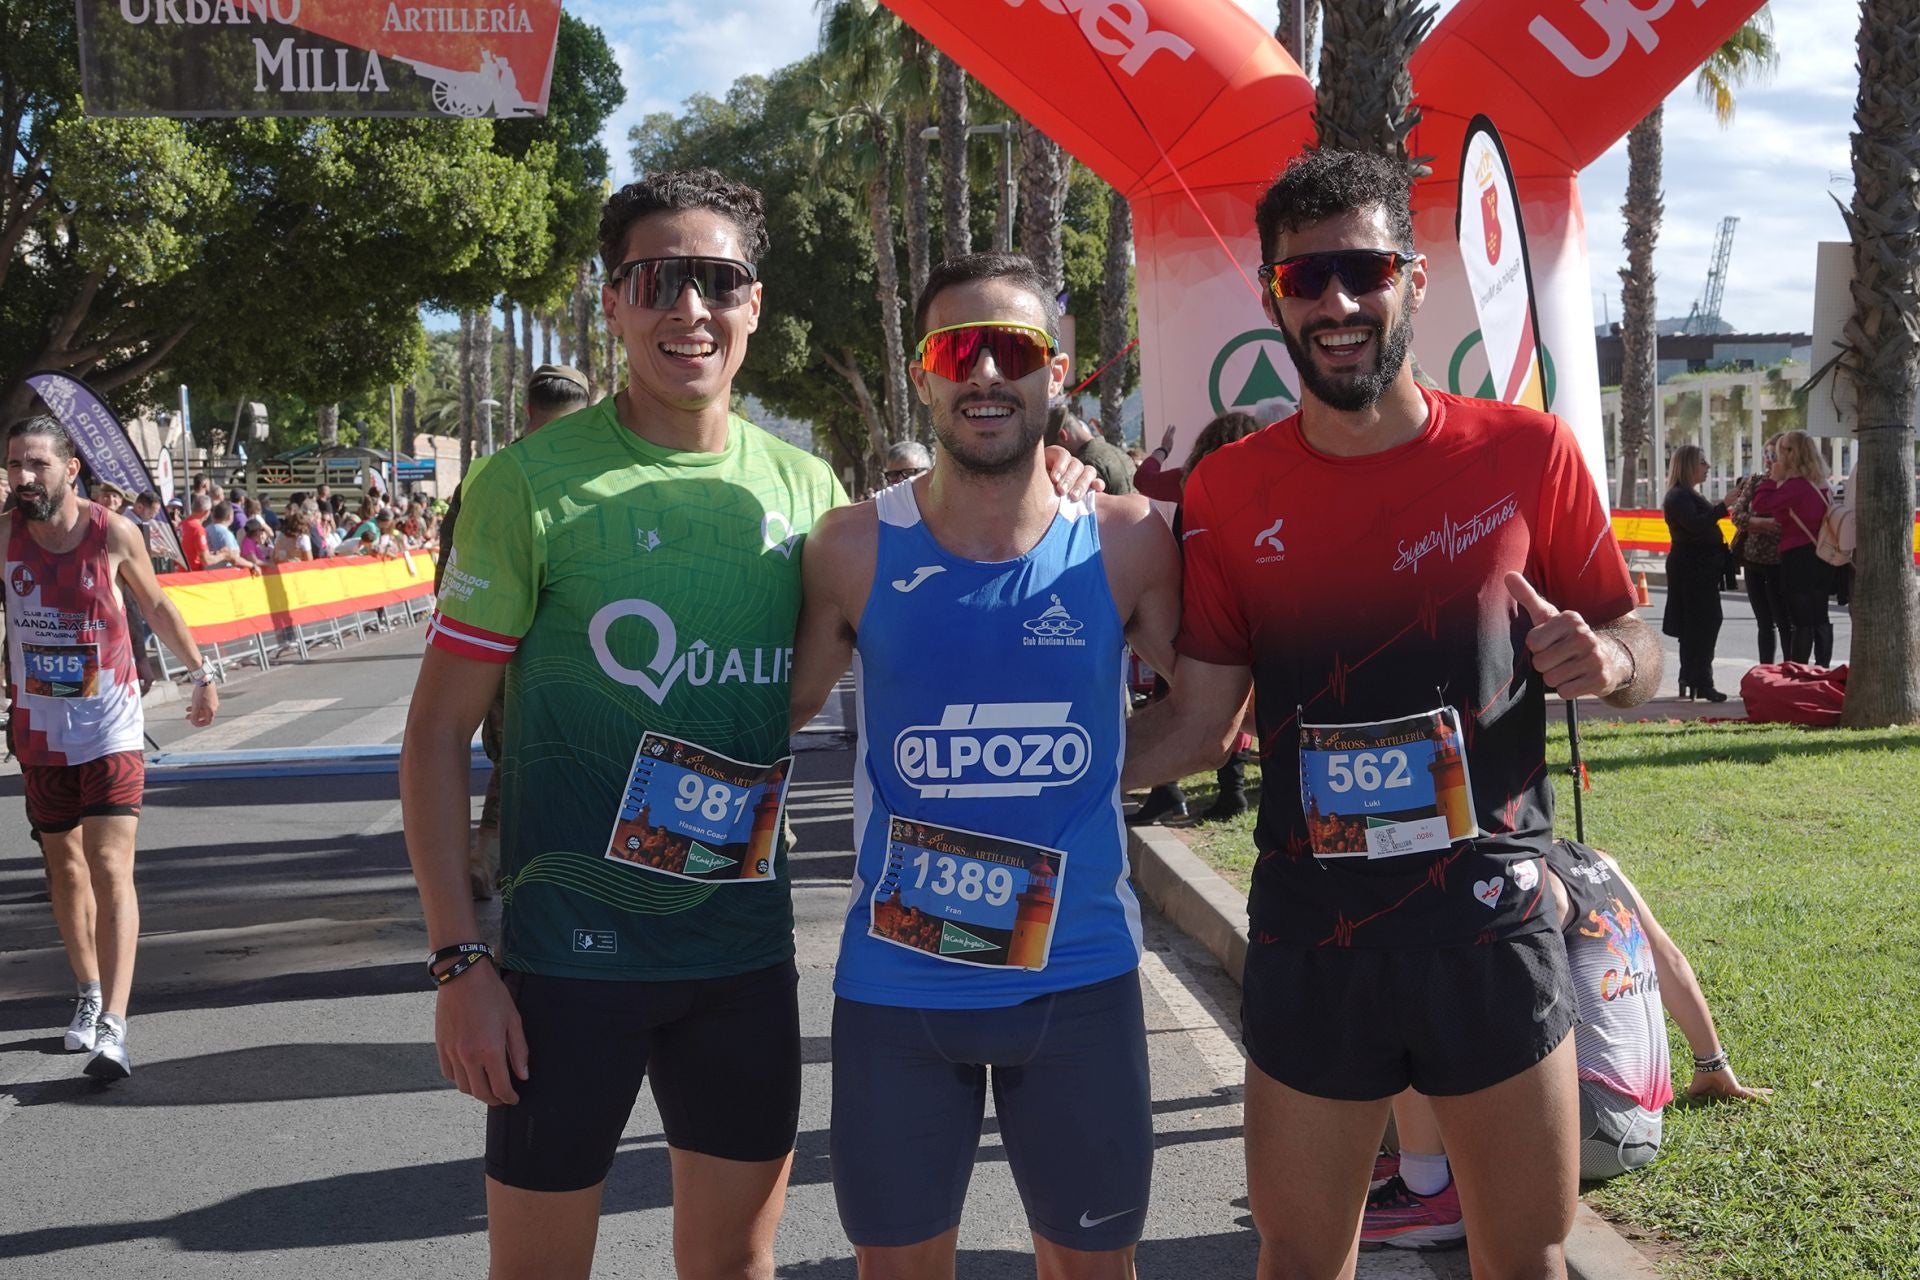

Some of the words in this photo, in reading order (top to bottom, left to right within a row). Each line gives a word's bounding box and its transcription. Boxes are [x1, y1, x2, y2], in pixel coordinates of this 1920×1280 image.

[382, 3, 534, 34] ARTILLERÍA
[252, 38, 390, 93] MILLA
[23, 610, 42, 618] CLUB
[1023, 636, 1037, 646] Club
[1066, 637, 1086, 646] Alhama
[33, 655, 81, 673] 1515
[1335, 740, 1366, 751] CROSS
[1375, 730, 1427, 748] ARTILLERÍA
[694, 763, 726, 780] CROSS
[1328, 749, 1412, 793] 562
[674, 774, 751, 824] 981
[679, 820, 705, 834] Hassan
[936, 842, 966, 855] CROSS
[974, 850, 1025, 868] ARTILLERÍA
[914, 852, 1013, 906] 1389
[945, 905, 962, 915] Fran
[459, 944, 478, 952] META
